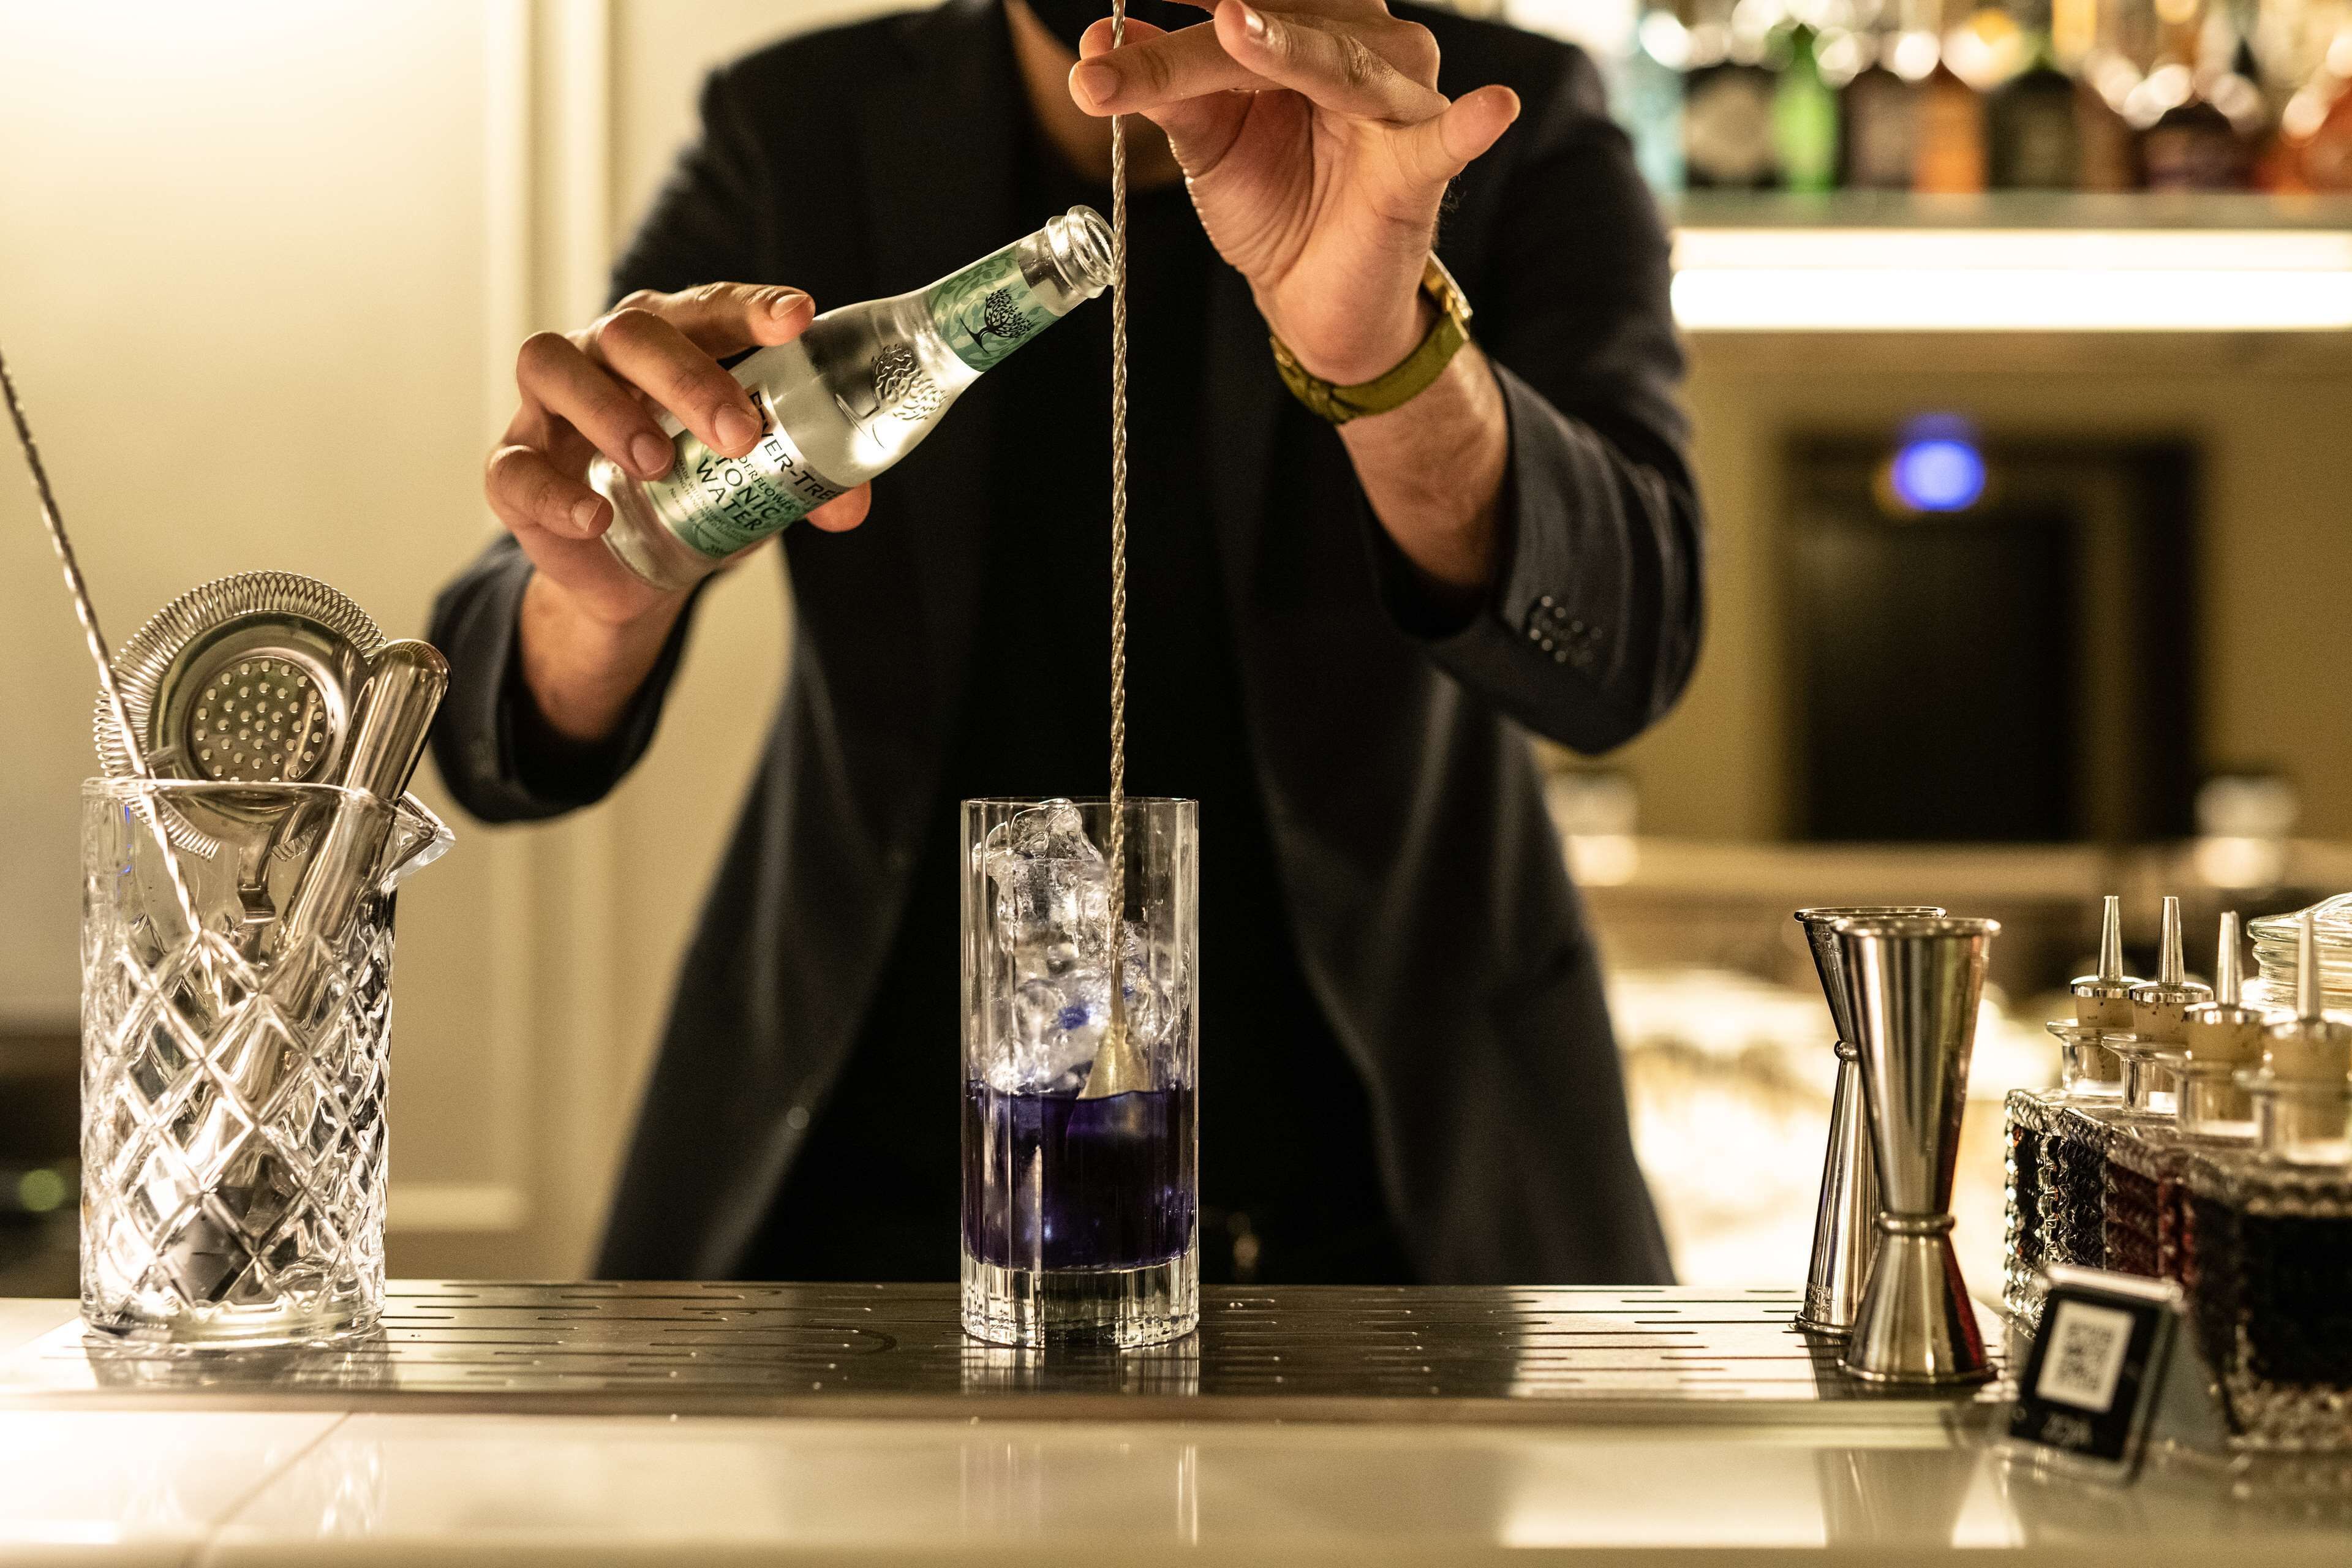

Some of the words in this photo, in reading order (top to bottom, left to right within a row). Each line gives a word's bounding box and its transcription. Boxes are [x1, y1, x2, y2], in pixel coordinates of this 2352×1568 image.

[750, 390, 843, 500] FVER-TREE
[696, 457, 763, 531] WATER
[715, 457, 780, 519] TONIC
[738, 455, 796, 510] DERFLOWER
